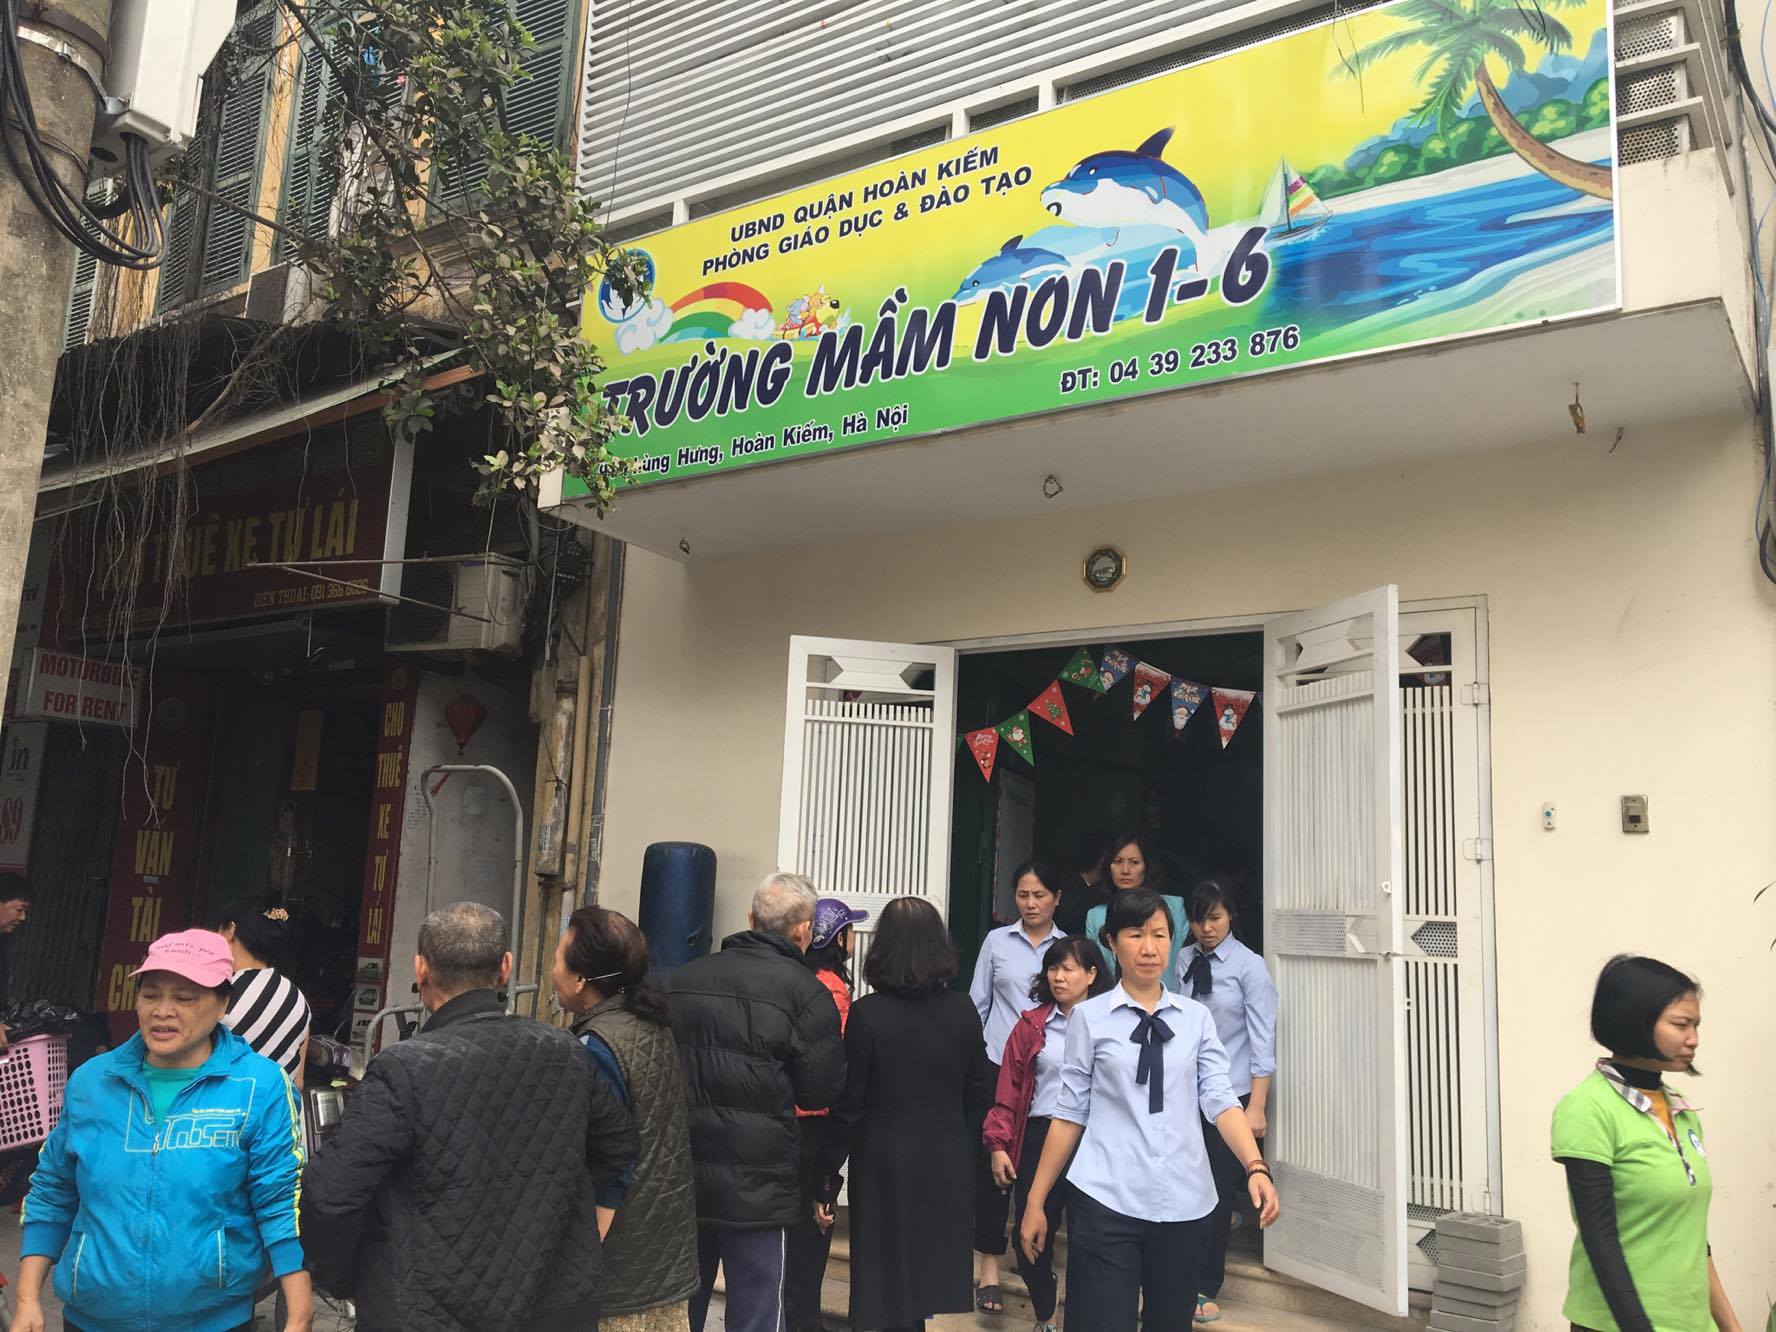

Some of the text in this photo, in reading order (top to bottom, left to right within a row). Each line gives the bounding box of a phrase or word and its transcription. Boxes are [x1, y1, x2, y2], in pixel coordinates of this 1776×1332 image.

[702, 166, 1032, 276] PHÒNG GIÁO DỤC & ĐÀO TẠO
[730, 146, 999, 244] UBND QUẬN HOÀN KIẾM
[602, 339, 792, 437] TRƯỜNG
[805, 286, 957, 397] MẦM
[973, 262, 1124, 361] NON
[1060, 326, 1300, 393] ĐT: 04 39 233 876
[677, 446, 724, 468] Hưng,
[731, 435, 775, 457] Hoàn
[783, 420, 833, 449] Kiếm,
[842, 411, 867, 435] Hà
[876, 404, 908, 433] Nội
[223, 517, 261, 573] XE
[309, 487, 359, 561] LÁI
[39, 653, 140, 690] MOTORBIKE
[43, 689, 127, 722] FOR RENT
[384, 701, 405, 737] CHO
[377, 744, 403, 788] THUÊ
[134, 817, 174, 876] VẤN
[377, 804, 391, 839] XE
[130, 886, 162, 942] TÀI
[366, 893, 383, 945] LÁI
